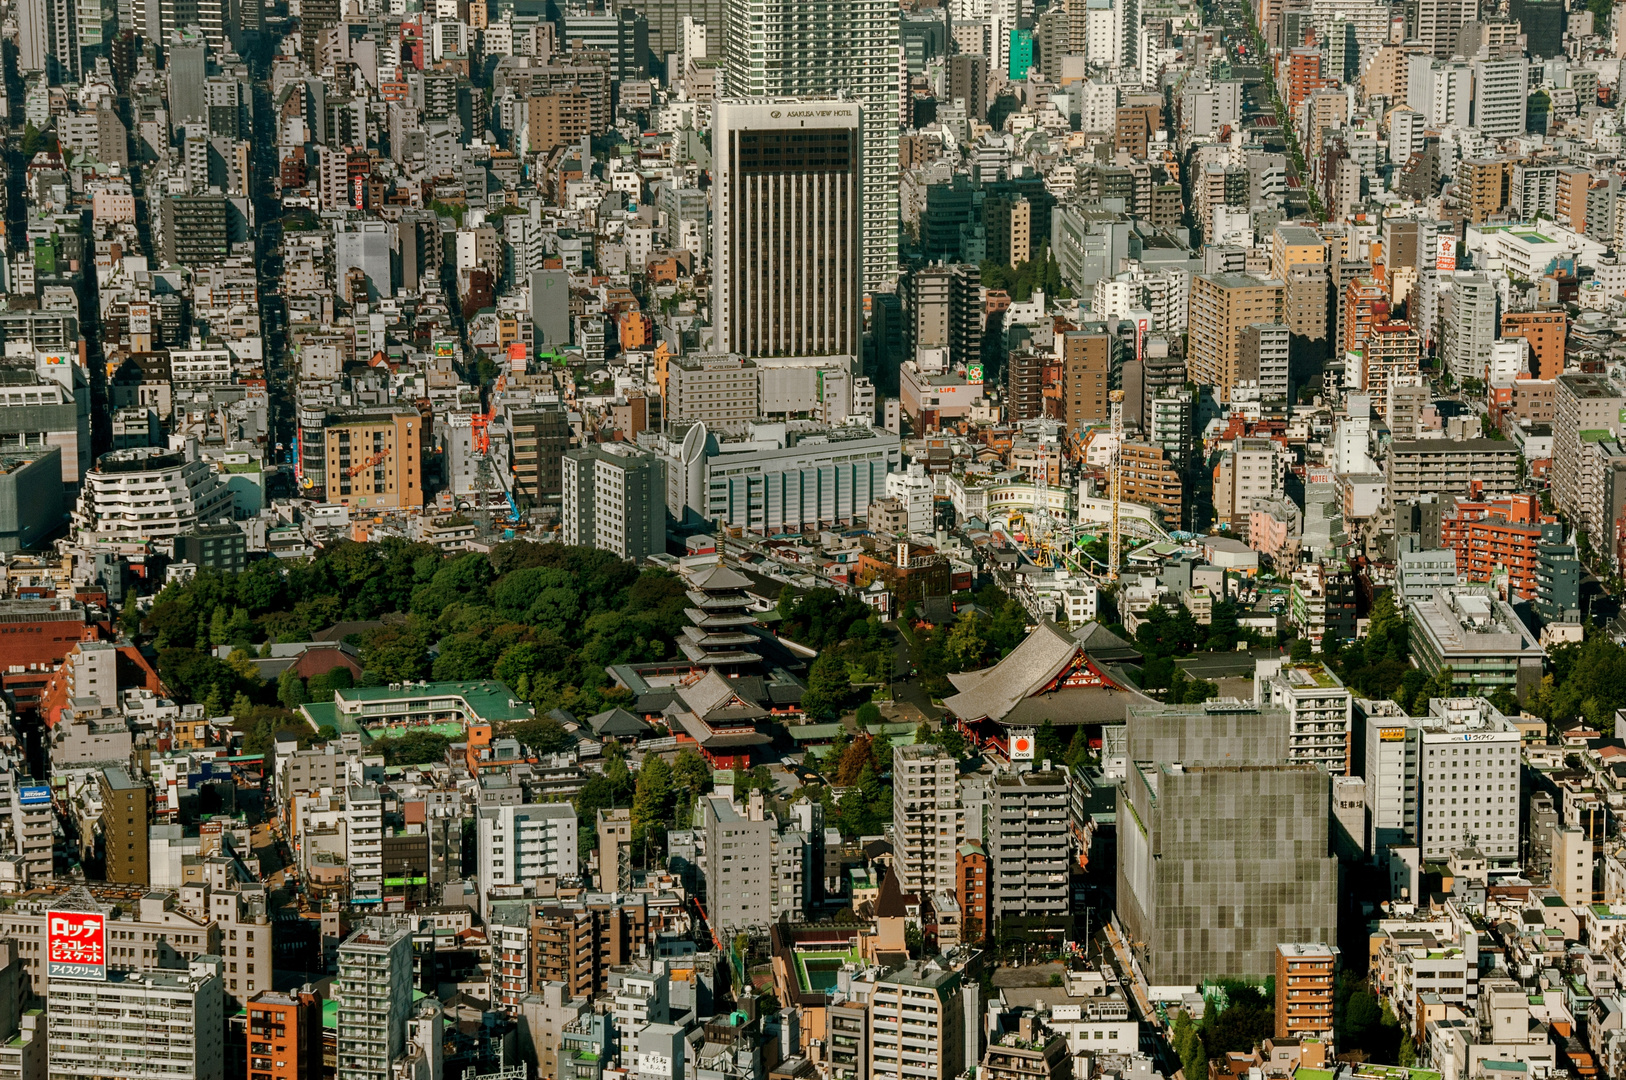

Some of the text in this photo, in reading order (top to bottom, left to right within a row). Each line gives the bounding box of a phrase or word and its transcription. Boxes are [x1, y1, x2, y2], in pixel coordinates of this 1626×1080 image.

[546, 278, 555, 290] P
[46, 356, 66, 365] ROX
[1311, 475, 1328, 483] HOTEL
[1340, 800, 1363, 809] 駐車場
[51, 917, 101, 938] ロッテ
[51, 939, 102, 951] チョコレート
[52, 950, 102, 962] ビスケット
[51, 965, 102, 976] アイスクリーム
